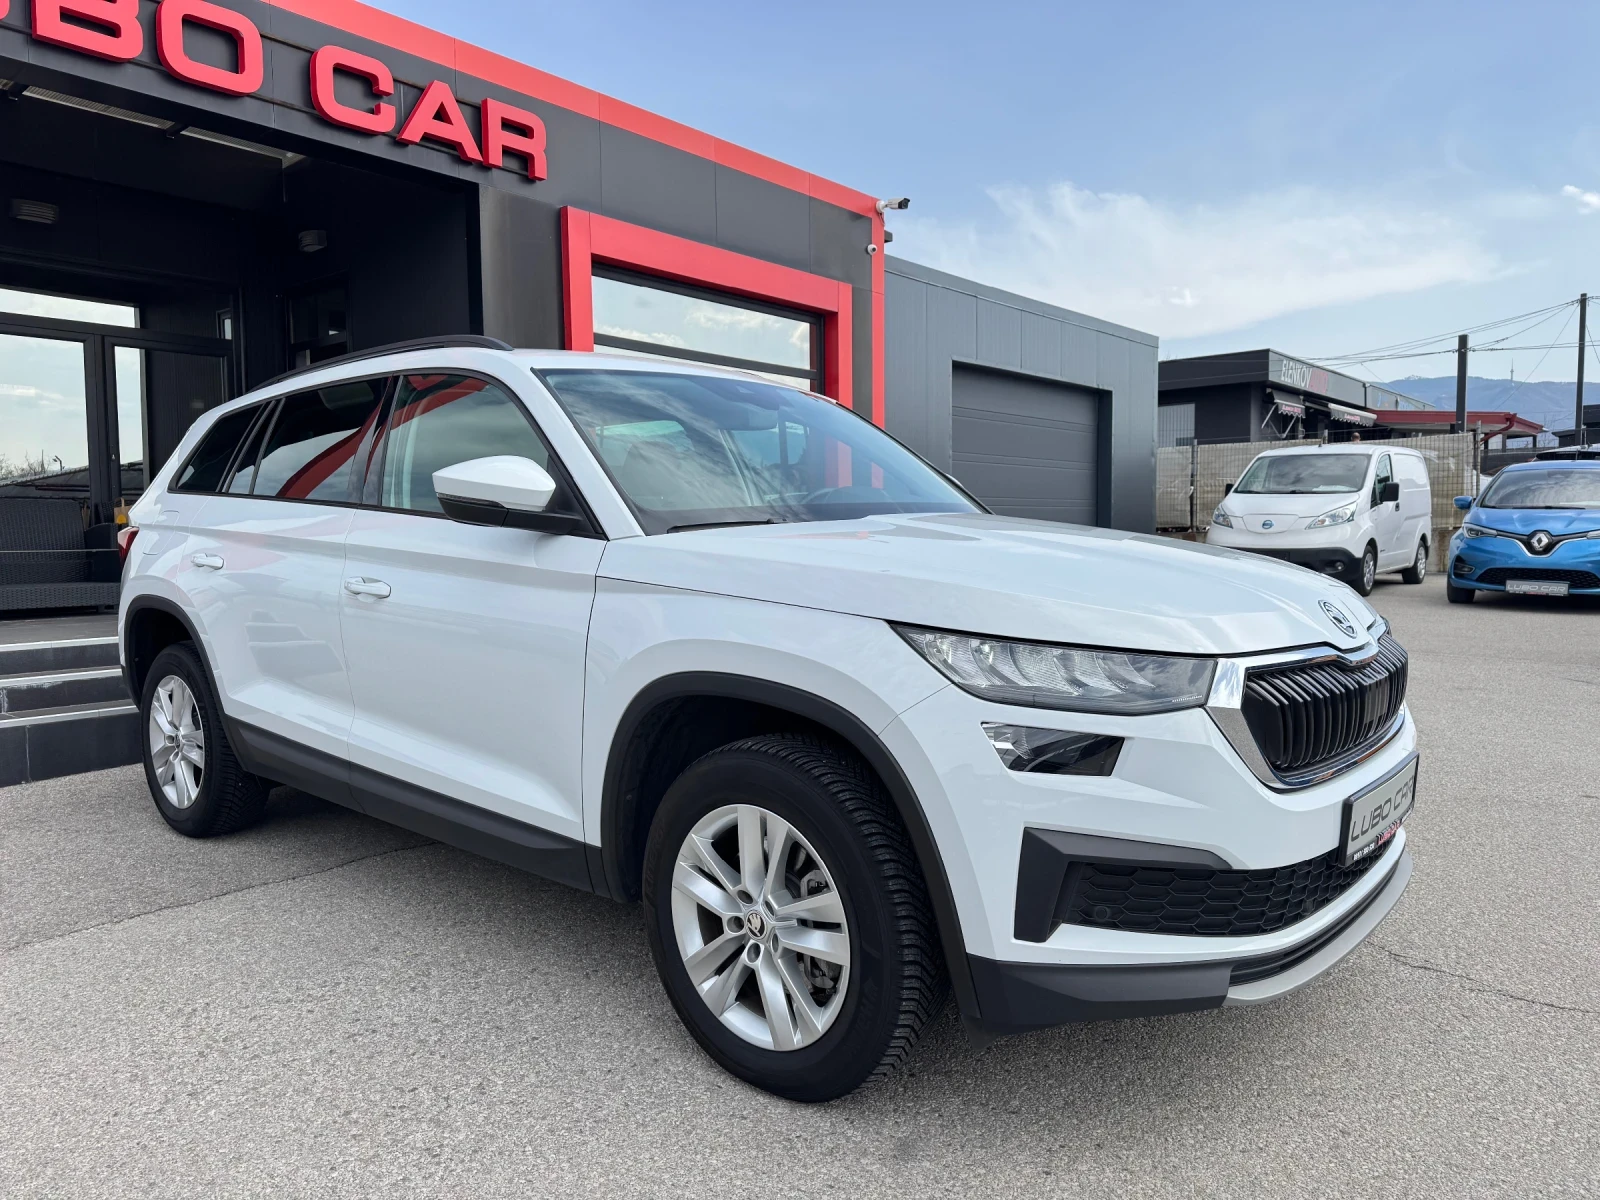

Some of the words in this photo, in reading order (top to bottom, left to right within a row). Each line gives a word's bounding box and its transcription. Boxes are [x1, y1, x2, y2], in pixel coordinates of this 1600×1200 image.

[0, 0, 263, 96] BO
[310, 45, 547, 181] CAR
[1350, 797, 1392, 842] LUBO
[1393, 775, 1414, 811] CAR
